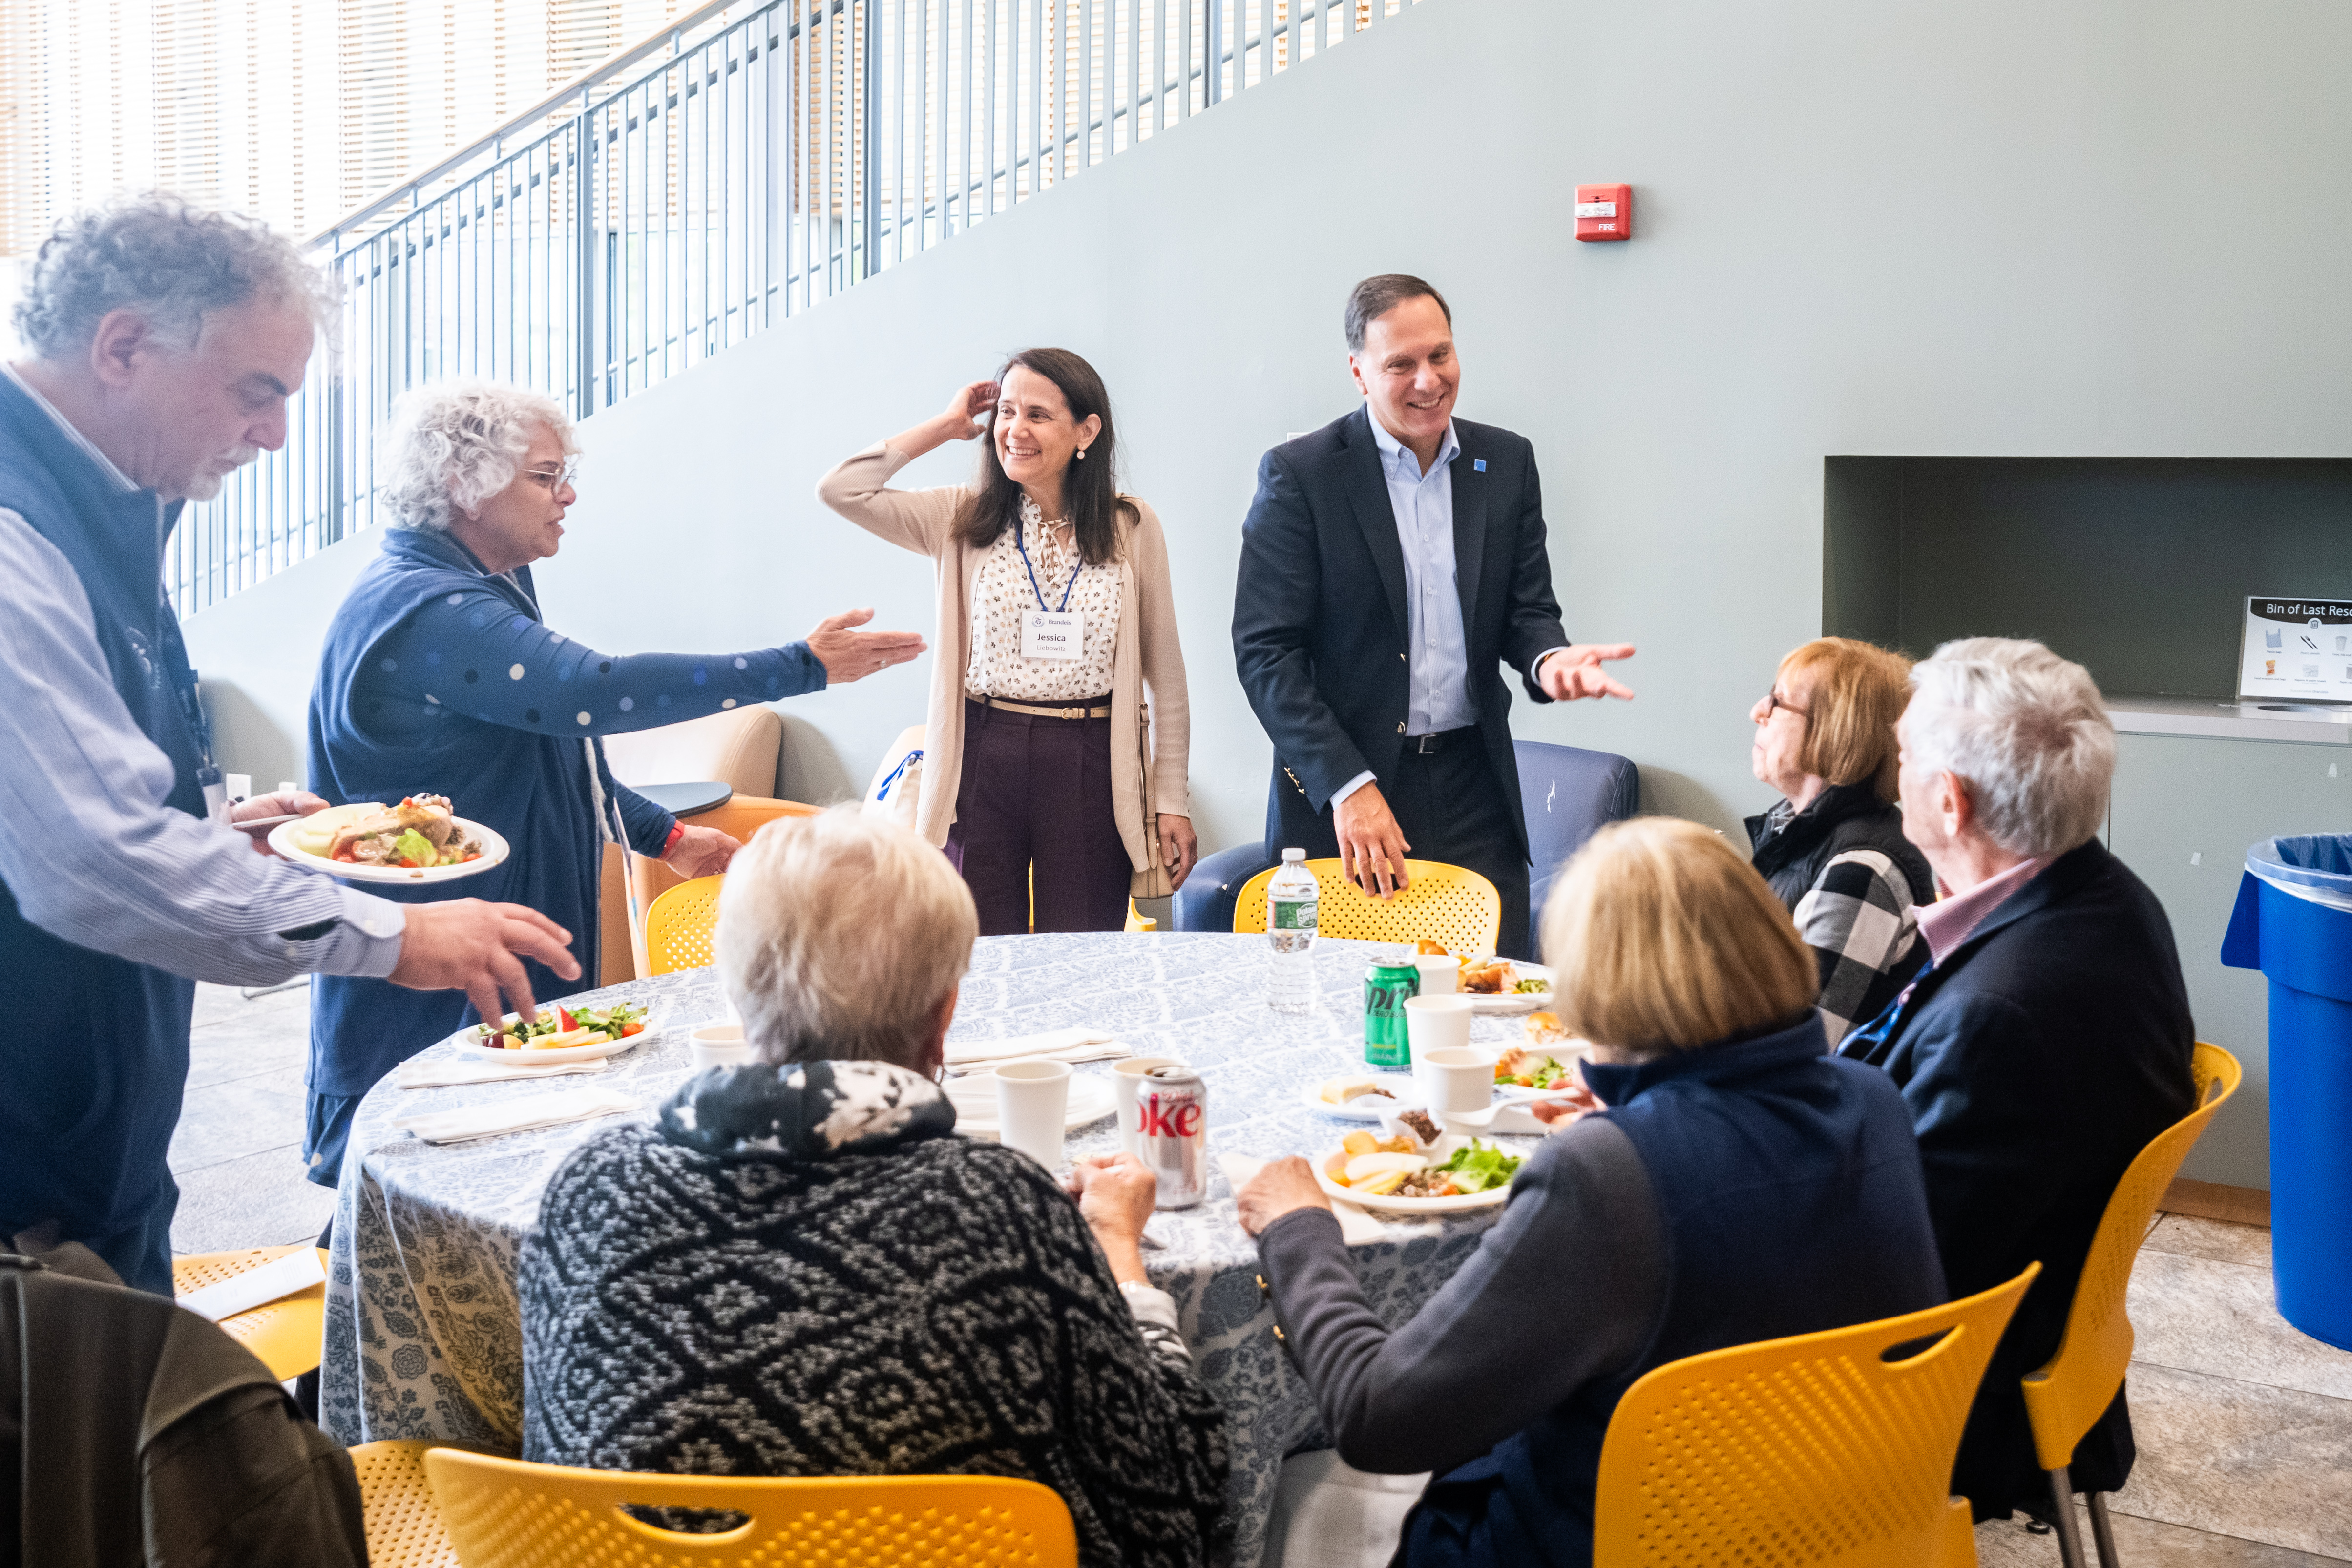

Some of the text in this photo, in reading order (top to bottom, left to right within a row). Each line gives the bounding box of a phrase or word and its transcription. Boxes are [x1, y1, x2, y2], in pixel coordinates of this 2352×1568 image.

[2267, 603, 2284, 613] Bin
[2288, 604, 2300, 614] of
[2303, 604, 2325, 615] Last
